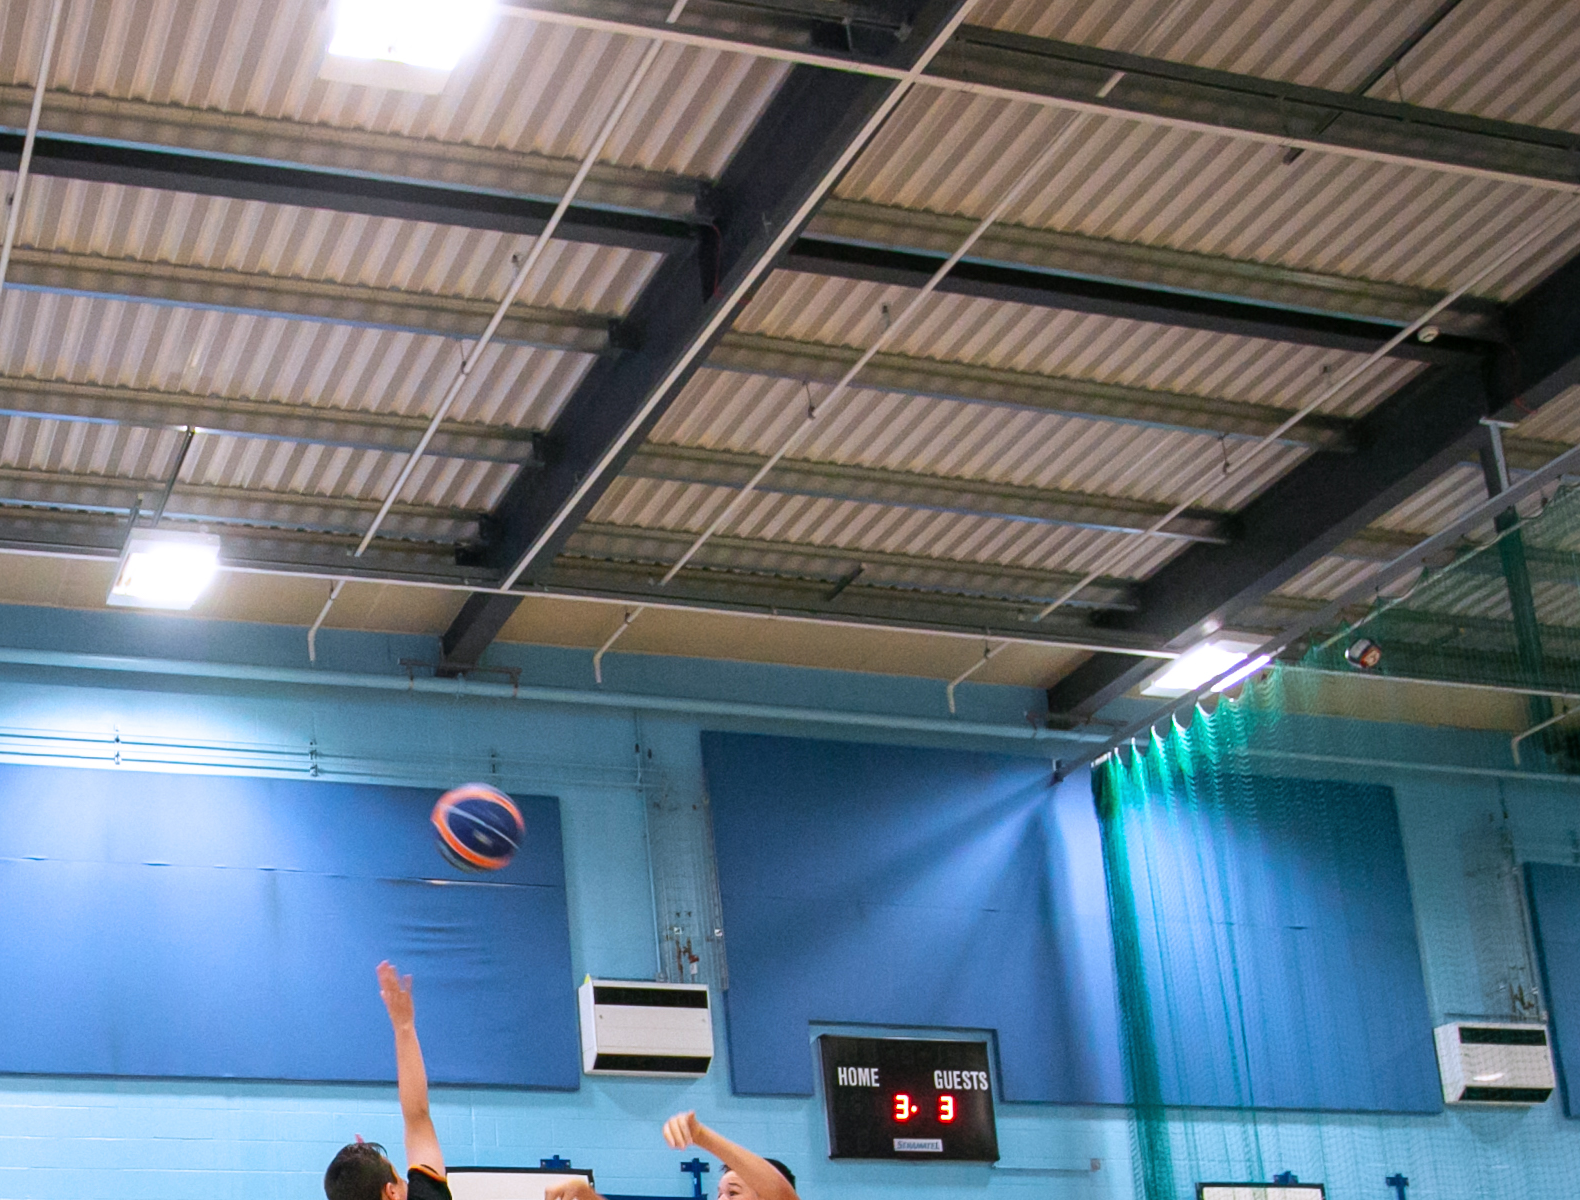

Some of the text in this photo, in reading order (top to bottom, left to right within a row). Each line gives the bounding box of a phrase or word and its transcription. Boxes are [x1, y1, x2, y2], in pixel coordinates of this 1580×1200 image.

[837, 1066, 989, 1091] HOME GUESTS
[938, 1095, 955, 1121] 3
